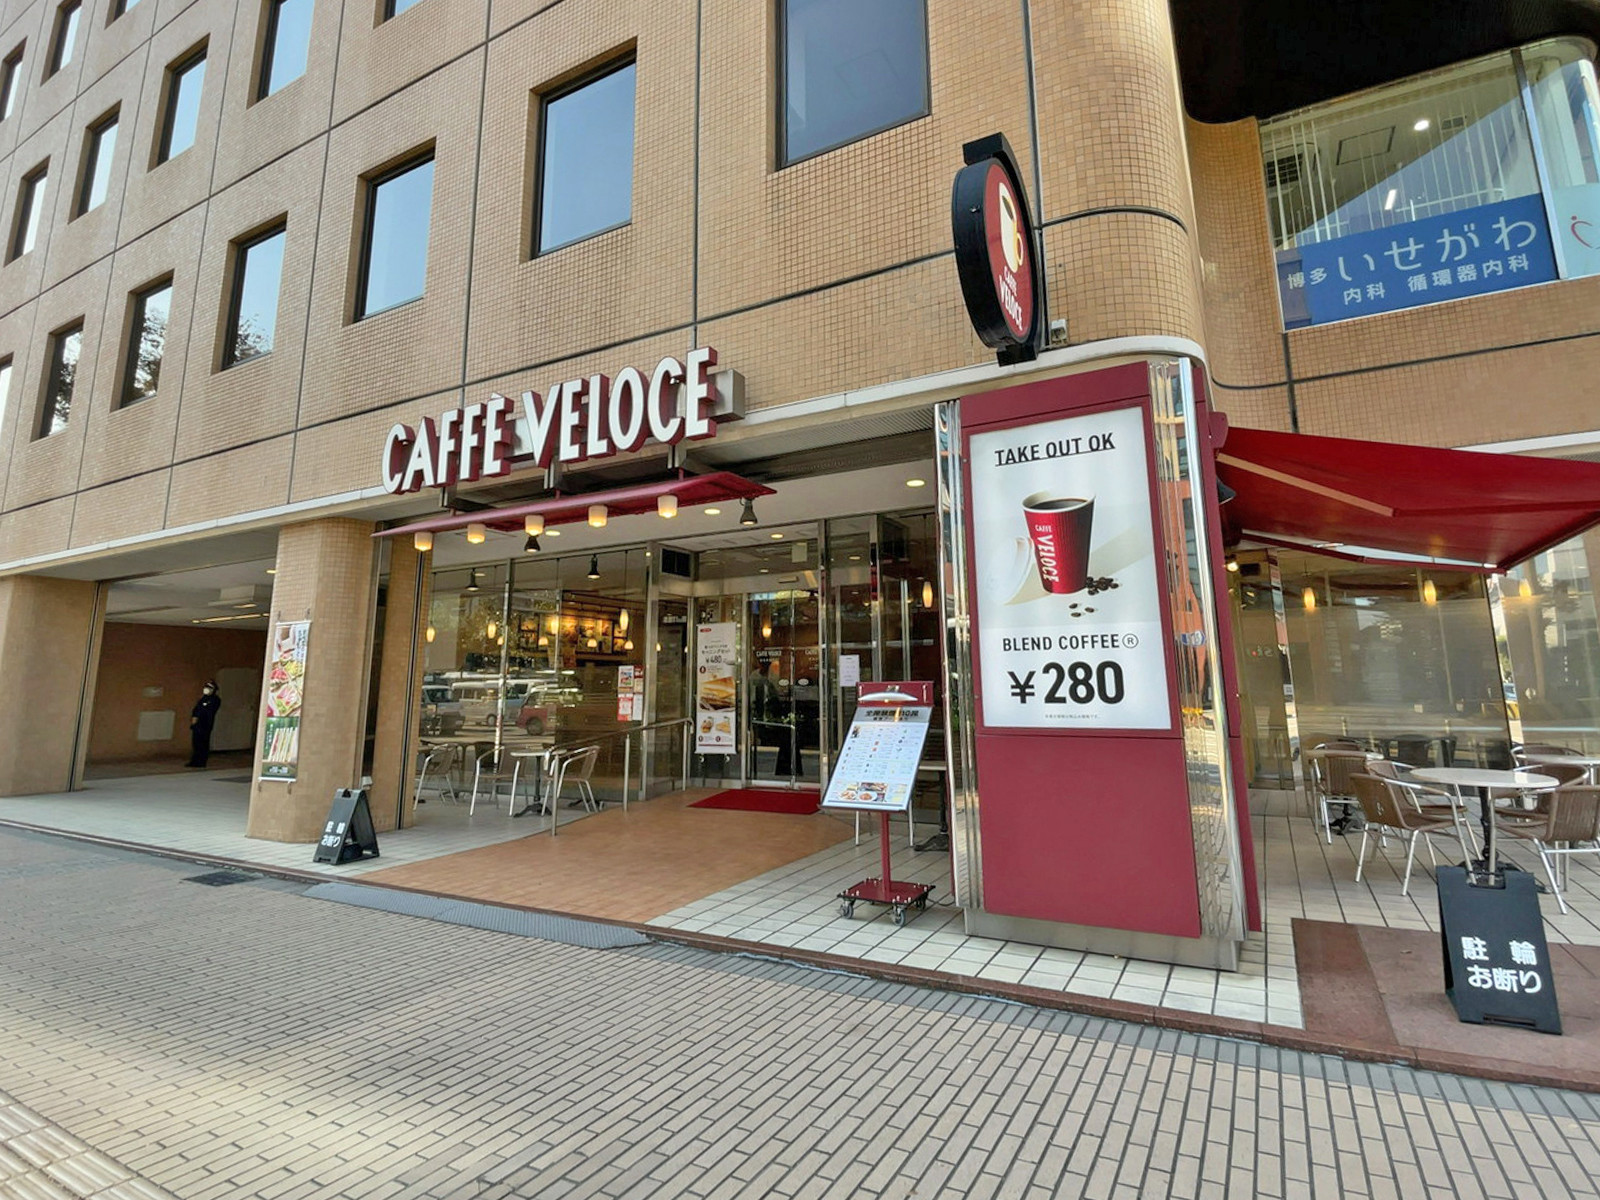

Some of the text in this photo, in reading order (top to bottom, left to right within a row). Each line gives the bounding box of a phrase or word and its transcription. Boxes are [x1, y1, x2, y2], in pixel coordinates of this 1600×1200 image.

[1287, 216, 1537, 290] 博多 いせがわ
[1343, 253, 1529, 305] 内科 循環器内科
[522, 346, 718, 468] VELOCE
[995, 433, 1116, 466] TAKE OUT OK
[1037, 534, 1060, 583] VELOCE
[1003, 637, 1052, 651] BLEND
[1007, 660, 1125, 705] ¥280
[1466, 965, 1542, 994] お断り
